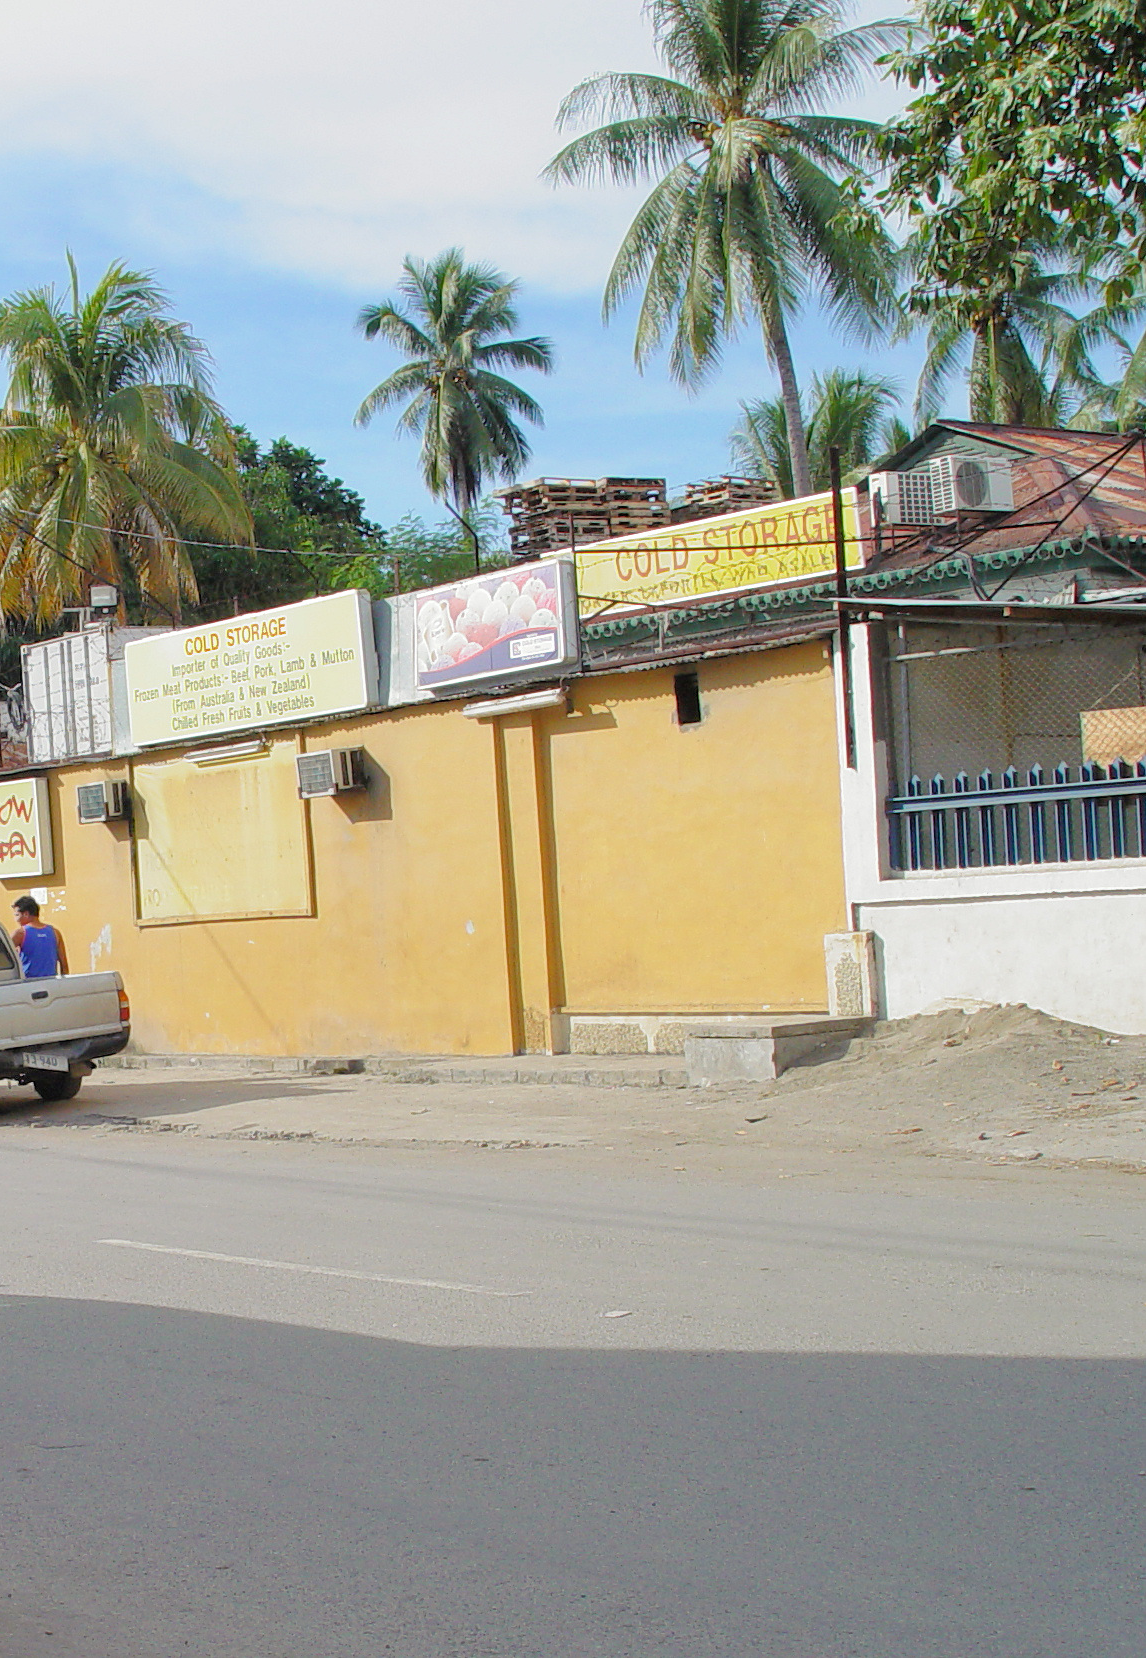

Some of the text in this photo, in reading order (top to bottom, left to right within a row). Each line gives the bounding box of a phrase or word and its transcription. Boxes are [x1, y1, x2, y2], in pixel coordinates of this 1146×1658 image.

[615, 536, 689, 582] COLD
[702, 502, 836, 564] STORAGE
[185, 617, 287, 656] COLD STORAGE
[134, 689, 159, 703] Frozen
[162, 681, 182, 697] Meat
[280, 656, 305, 673] Lamb
[310, 653, 317, 668] &
[321, 648, 355, 665] Mutton
[171, 660, 205, 677] Importer
[210, 655, 219, 669] of
[223, 650, 250, 667] Quality
[171, 695, 315, 731] Chilled Fresh Fruits & Vegetables
[172, 673, 311, 714] (From Australia & New Zealand)
